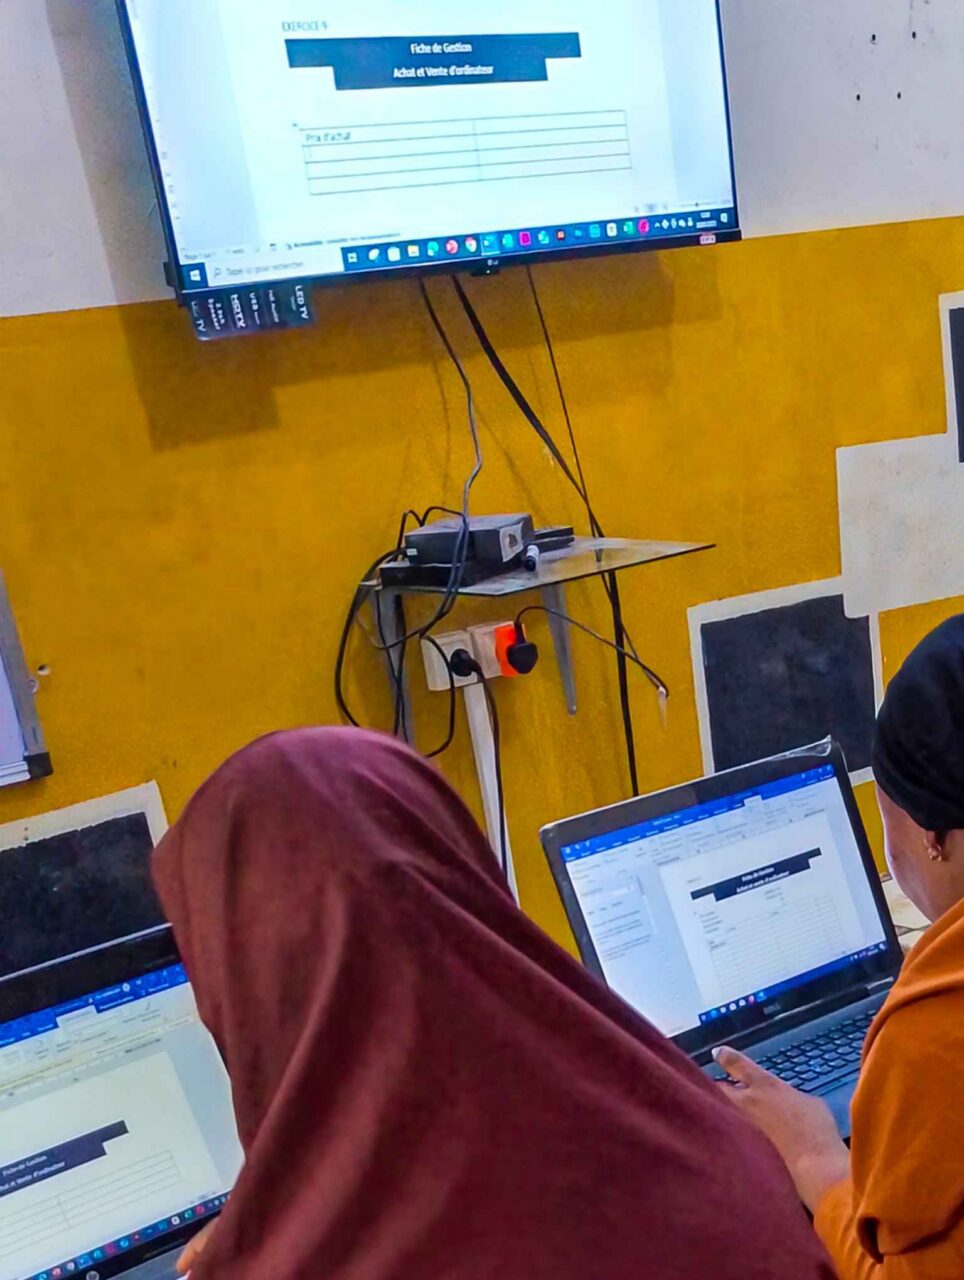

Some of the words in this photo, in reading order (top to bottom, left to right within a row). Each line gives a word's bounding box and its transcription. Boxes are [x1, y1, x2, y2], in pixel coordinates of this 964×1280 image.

[410, 43, 432, 54] Fiche
[432, 43, 443, 53] de
[443, 42, 473, 53] Gestion
[393, 67, 416, 78] Achat
[416, 66, 426, 77] et
[426, 66, 449, 76] Vente
[295, 285, 305, 305] LED
[300, 305, 309, 319] TV
